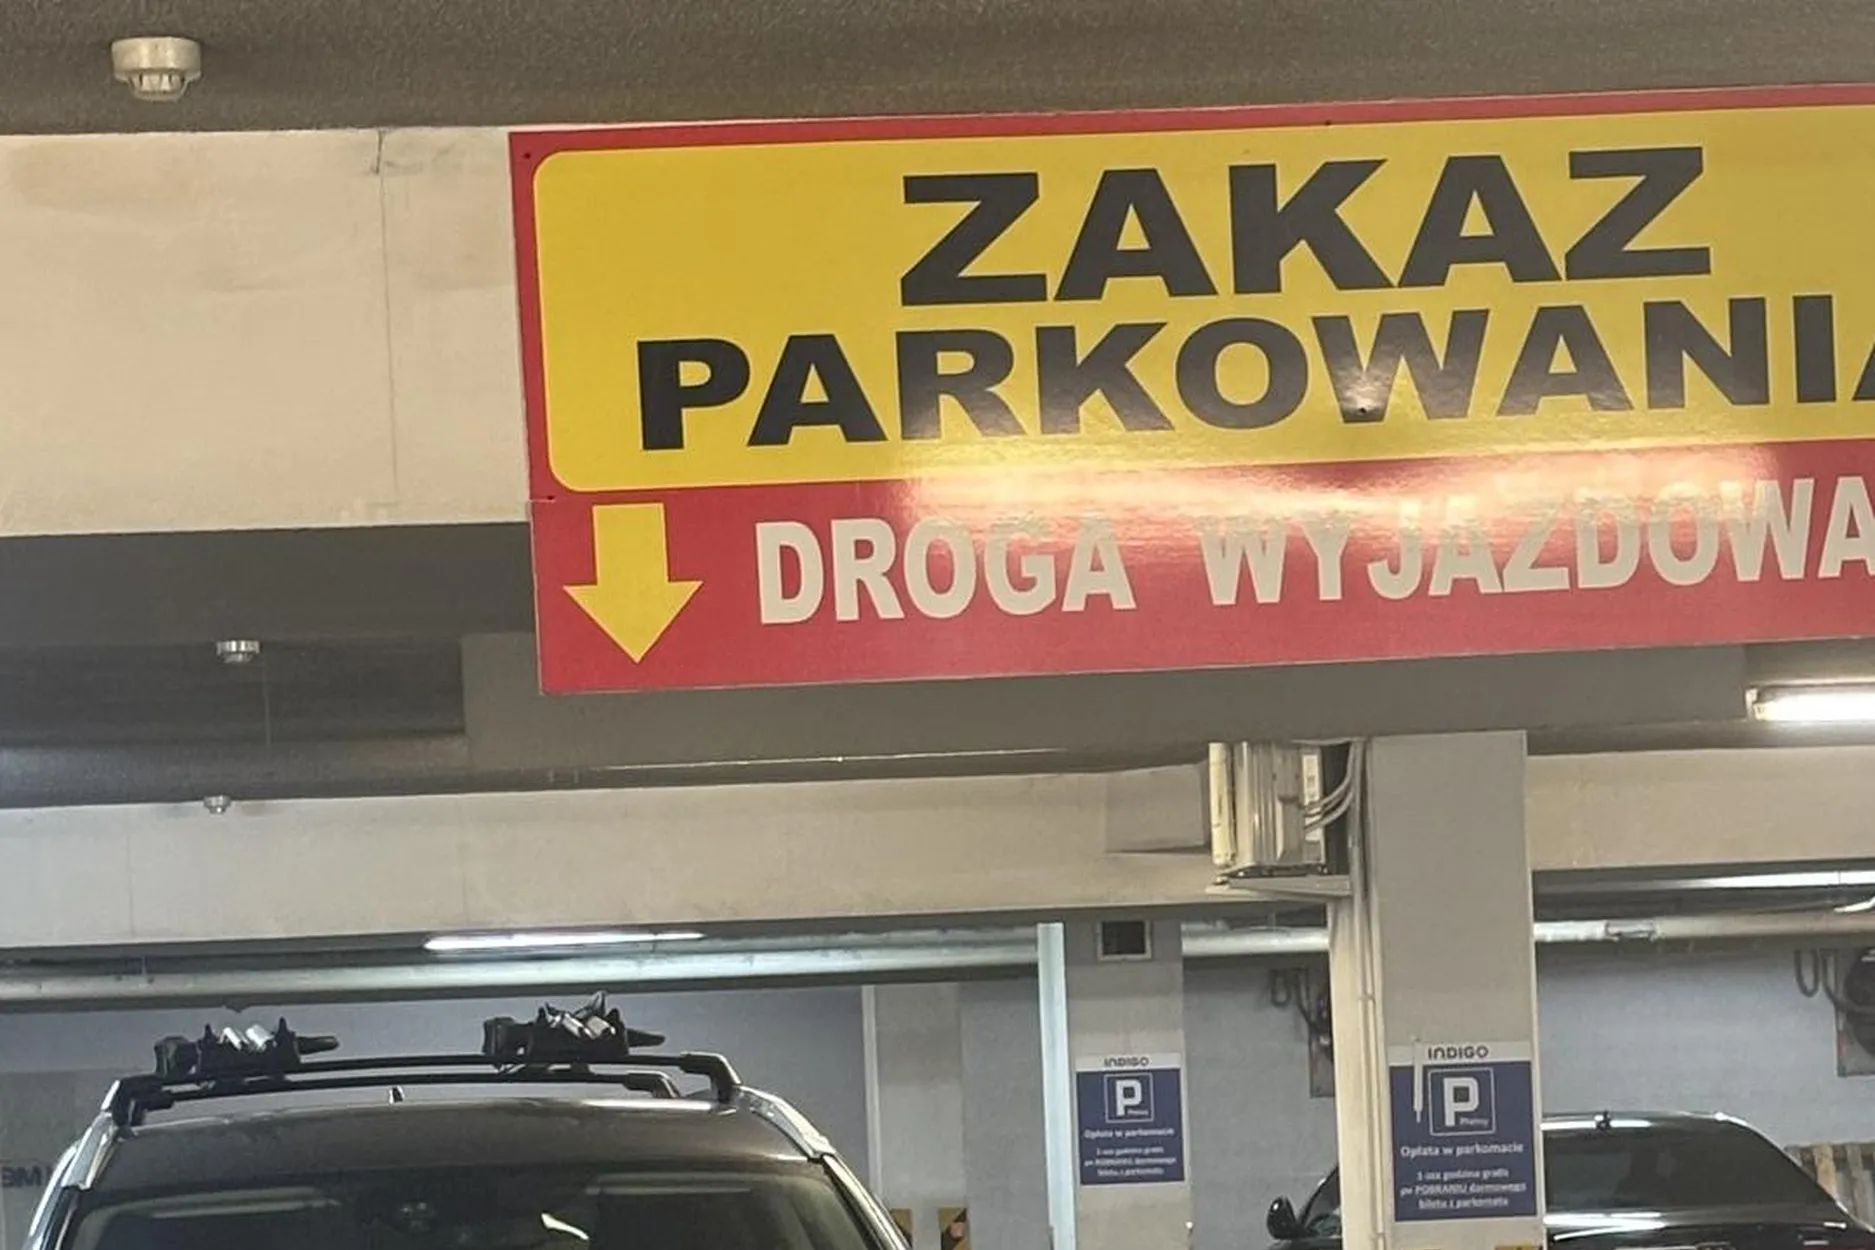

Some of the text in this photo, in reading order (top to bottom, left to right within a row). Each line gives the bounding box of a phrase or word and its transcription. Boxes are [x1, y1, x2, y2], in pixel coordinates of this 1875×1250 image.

[900, 147, 1711, 306] ZAKAZ
[757, 476, 1875, 625] DROGA WYJAZDOWA
[1428, 1046, 1489, 1060] INDIGO
[1116, 1079, 1142, 1116] P
[1444, 1077, 1479, 1126] P
